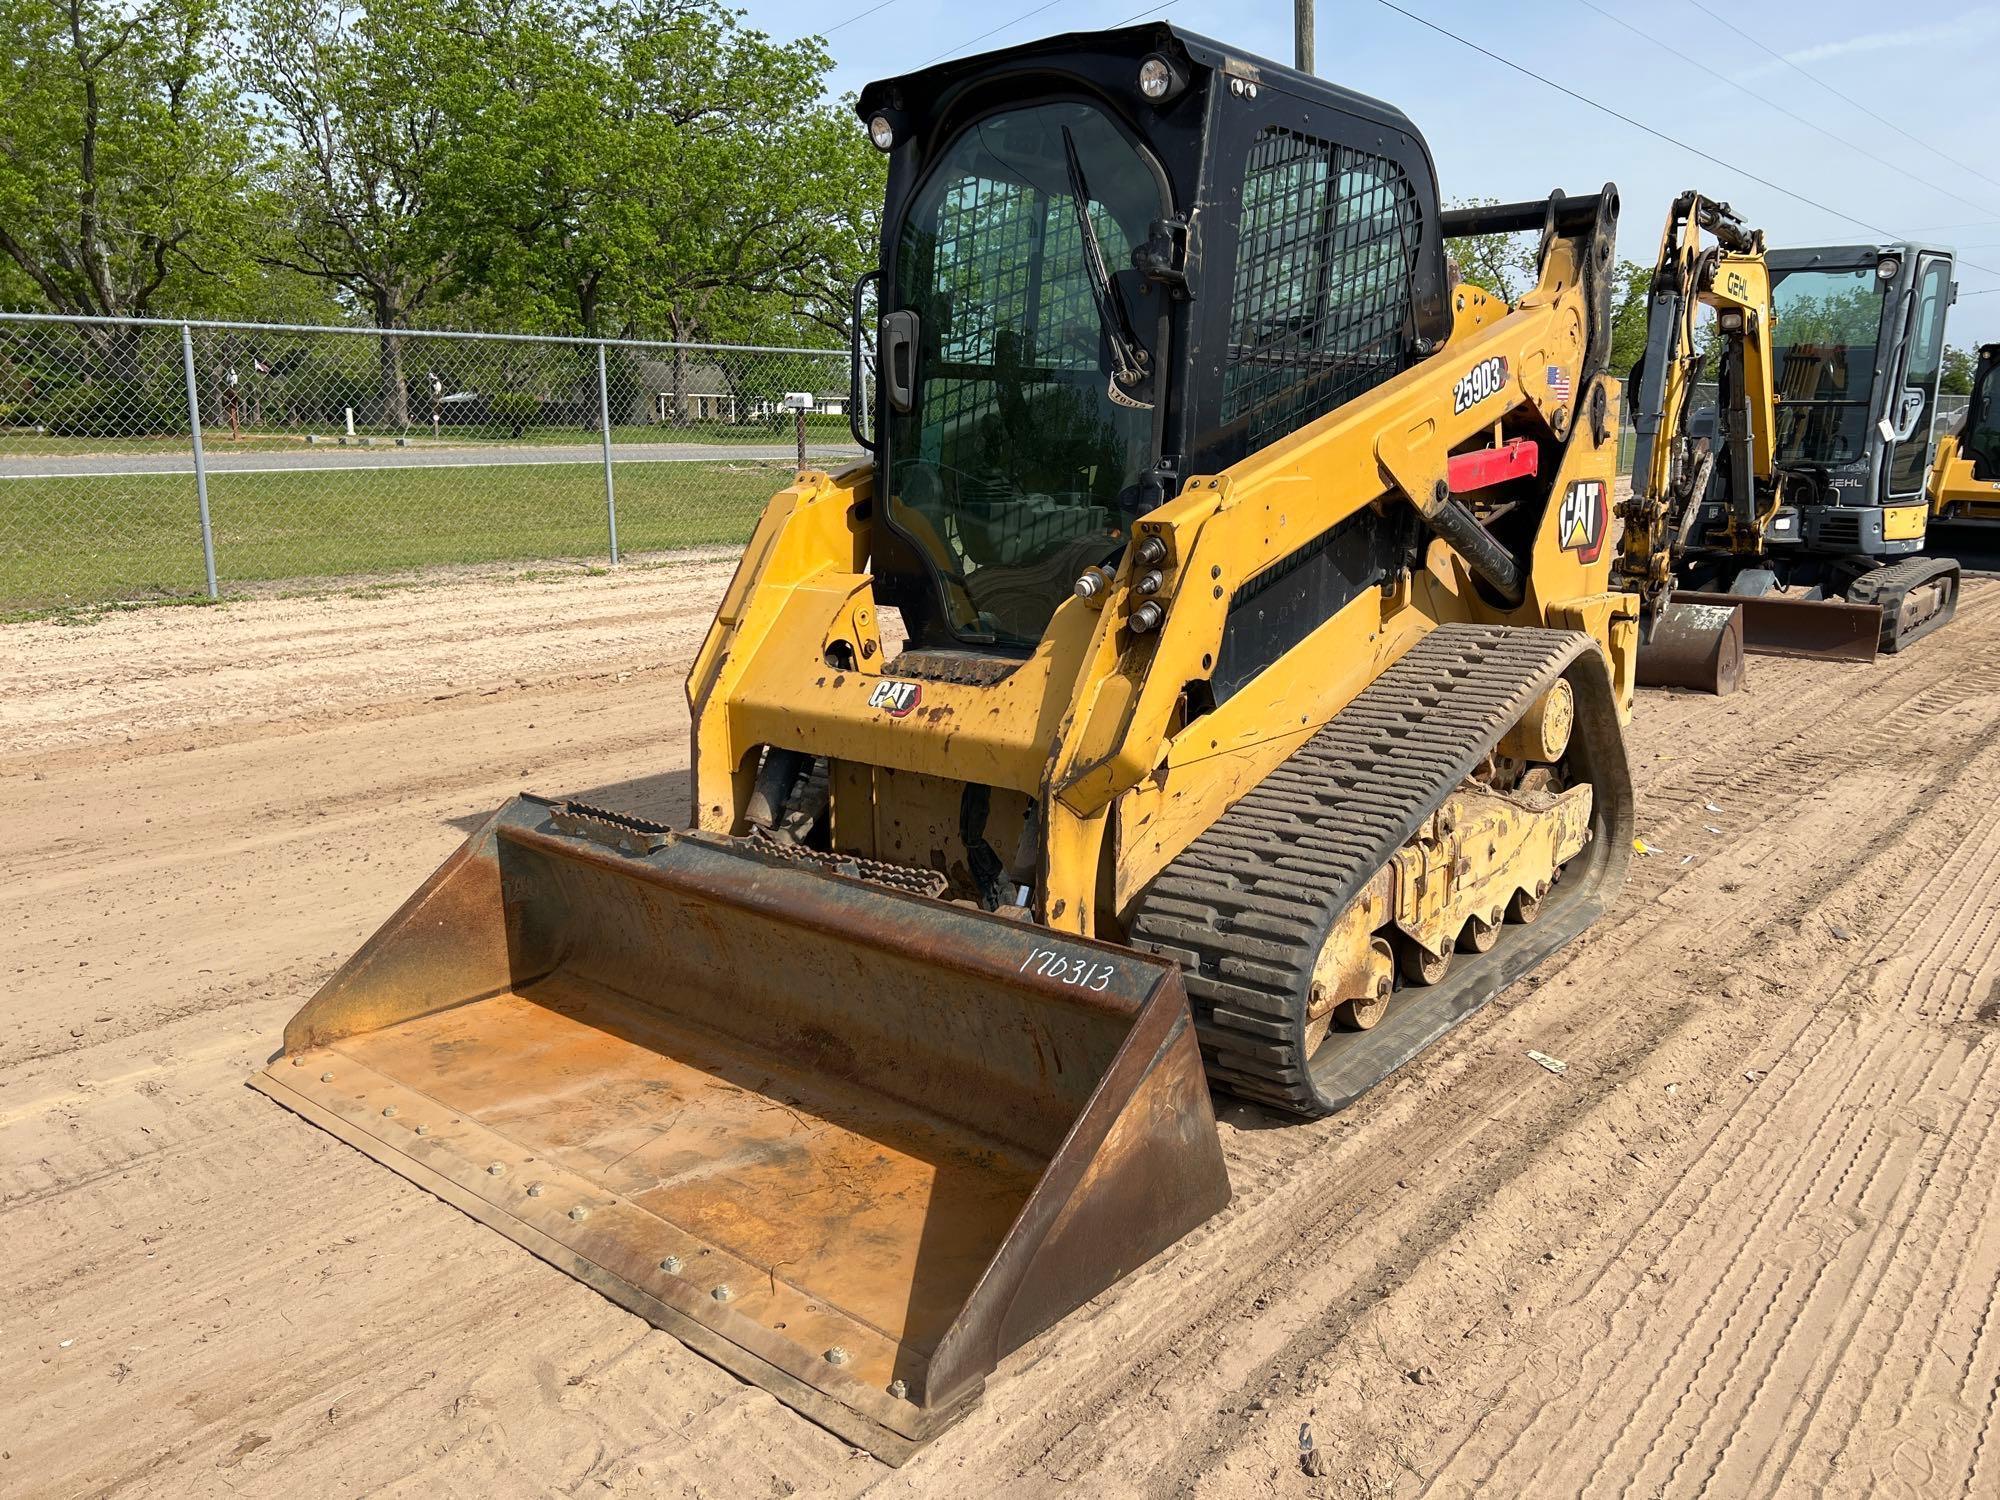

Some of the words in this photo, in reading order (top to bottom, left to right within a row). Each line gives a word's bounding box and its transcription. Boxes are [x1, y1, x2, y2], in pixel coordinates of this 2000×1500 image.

[1727, 271, 1749, 301] GEHL
[1453, 356, 1501, 416] 259D3
[1560, 482, 1600, 548] CAT
[868, 680, 917, 710] CAT
[1019, 947, 1115, 992] 170313
